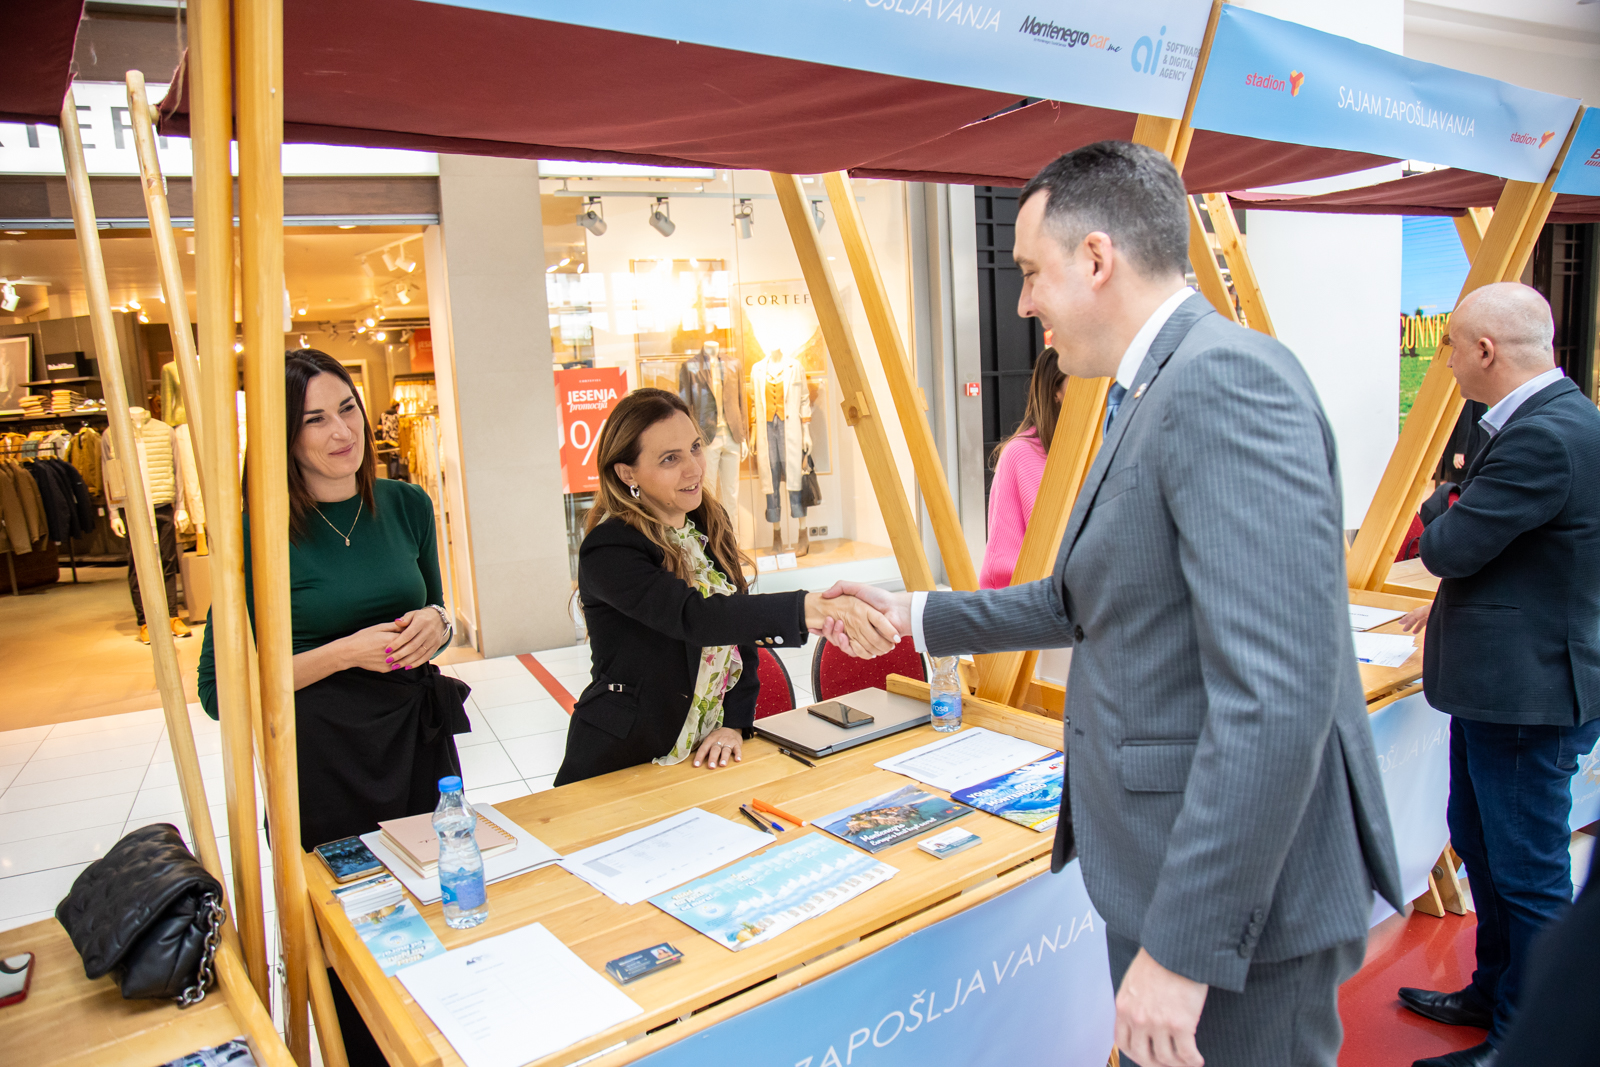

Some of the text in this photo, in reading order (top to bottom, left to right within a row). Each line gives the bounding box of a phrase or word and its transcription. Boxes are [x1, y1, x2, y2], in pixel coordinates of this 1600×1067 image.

[1163, 54, 1194, 70] & DIGITAL
[1159, 67, 1187, 81] AGENCY
[1245, 72, 1286, 92] stadion
[1338, 85, 1475, 137] SAJAM ZAPOŠLJAVANJA
[1510, 131, 1538, 146] stadion
[745, 293, 810, 306] CORTEF
[567, 388, 617, 405] JESENJA
[569, 400, 608, 413] promocija
